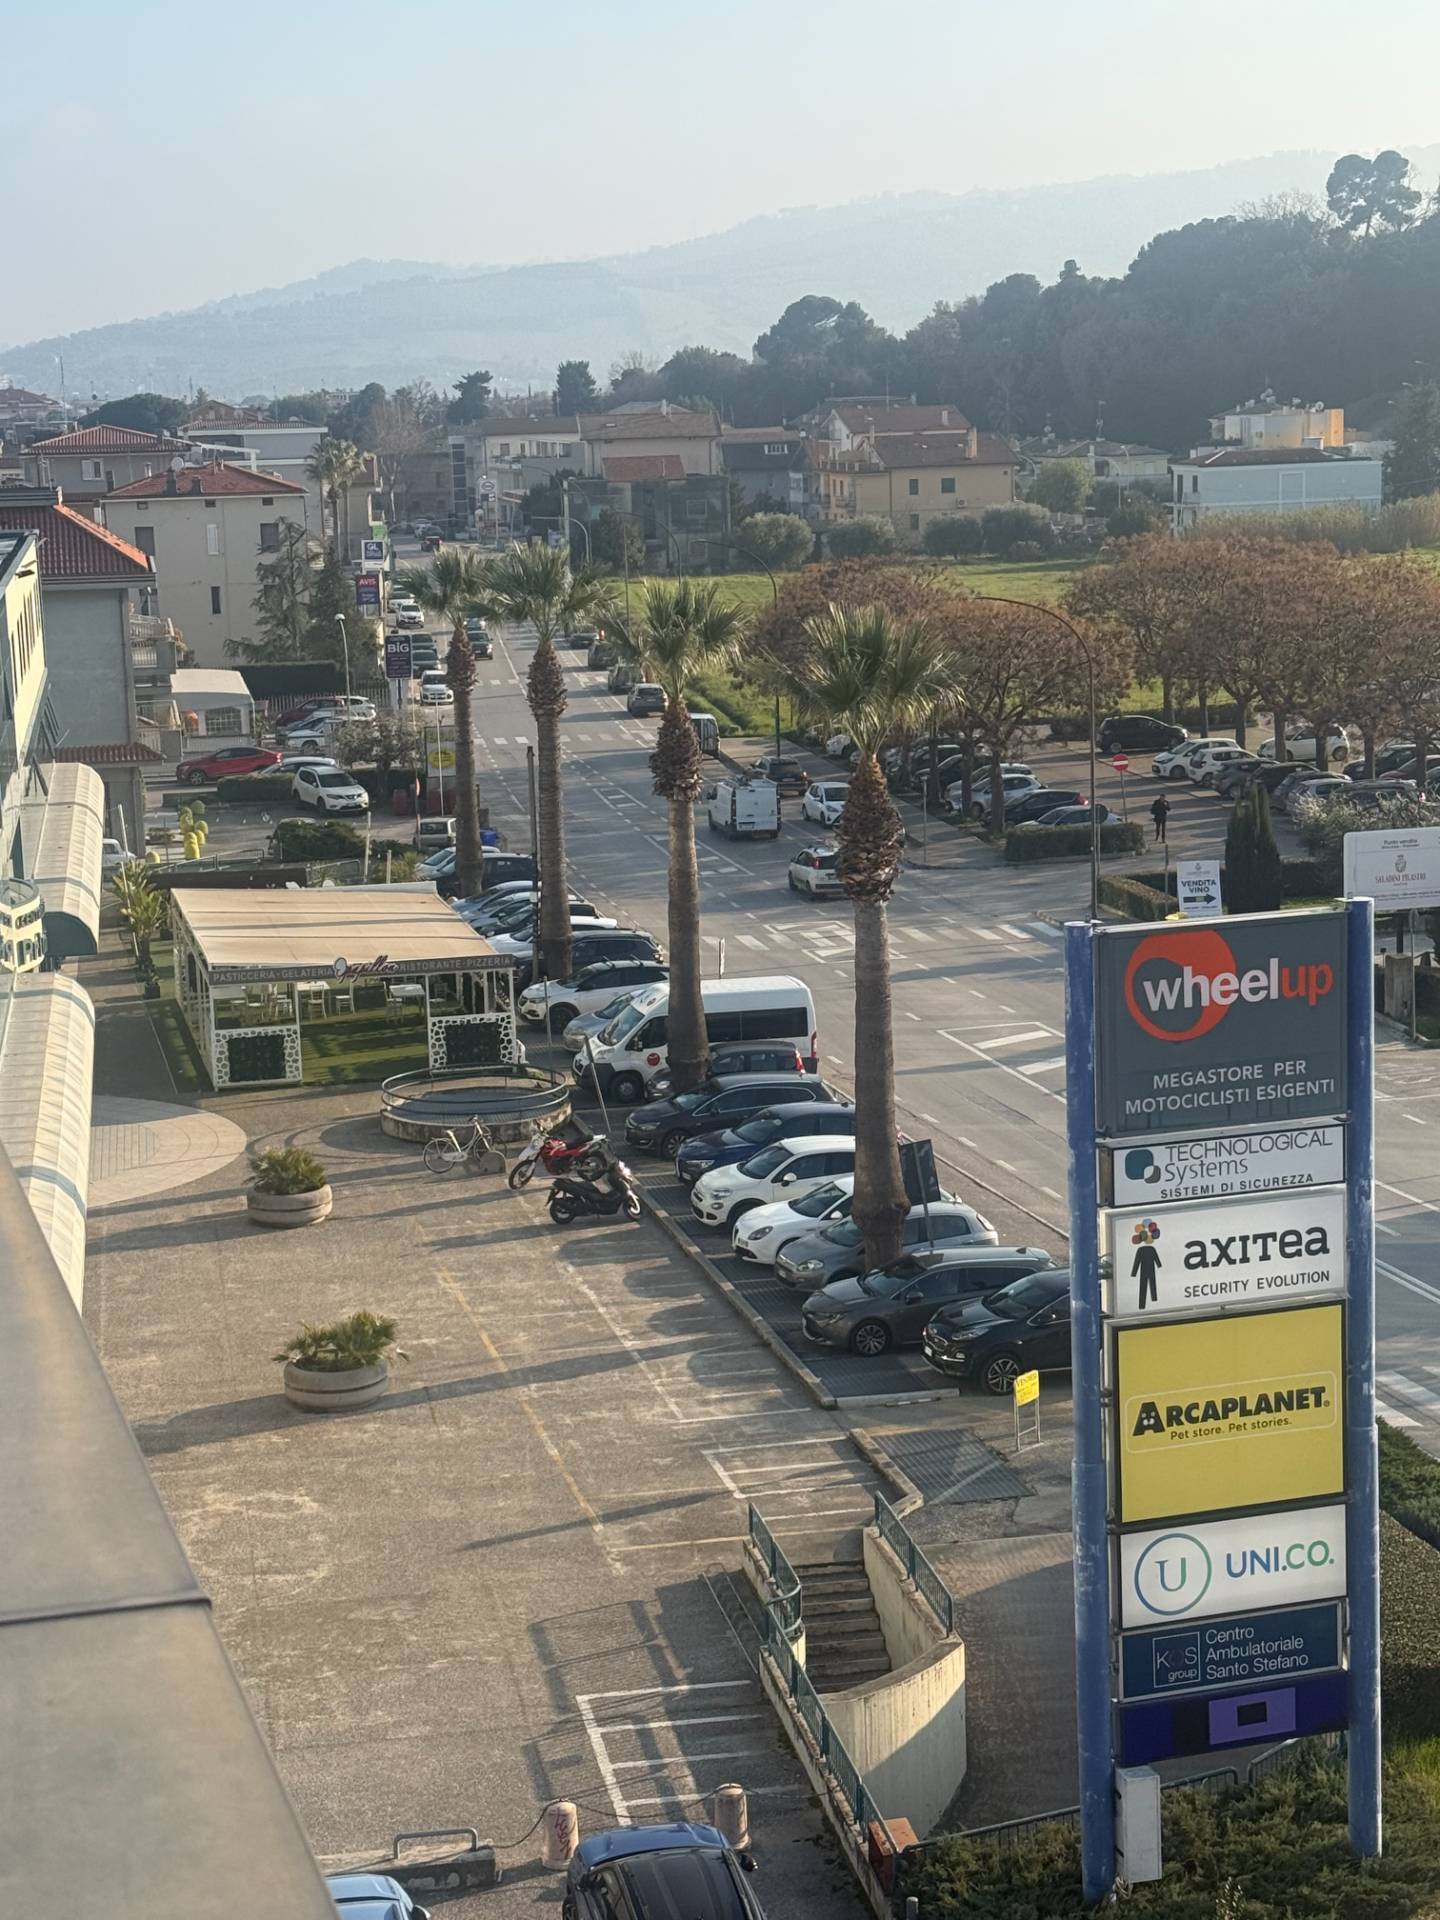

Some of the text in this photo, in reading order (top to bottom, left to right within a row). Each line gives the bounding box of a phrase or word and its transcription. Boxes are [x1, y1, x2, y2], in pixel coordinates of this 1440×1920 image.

[1181, 879, 1217, 888] VENDITA
[1189, 886, 1210, 894] VINO
[212, 967, 335, 982] PASTICCERIA GELATERIA
[400, 956, 512, 973] RISTORANTE PIZZERIA
[1143, 957, 1333, 1012] wheelup
[1153, 1060, 1306, 1090] MEGASTORE PER
[1125, 1079, 1335, 1115] MOTOCICLISTI ESIGENTI
[1165, 1129, 1333, 1163] TECHNOLOGICAL
[1164, 1157, 1248, 1186] Systems
[1160, 1173, 1314, 1199] SISTEMI DI SICUREZZA
[1184, 1270, 1330, 1298] SECURITY EVOLUTION
[1170, 1428, 1189, 1440] Pet
[1192, 1425, 1224, 1438] store.
[1228, 1420, 1248, 1433] Pet
[1226, 1540, 1335, 1578] UNI.CO.
[1206, 1626, 1255, 1645] Centro
[1206, 1636, 1304, 1663] Ambulatoriale
[1168, 1668, 1198, 1682] group
[1206, 1654, 1309, 1680] Santo Stefano
